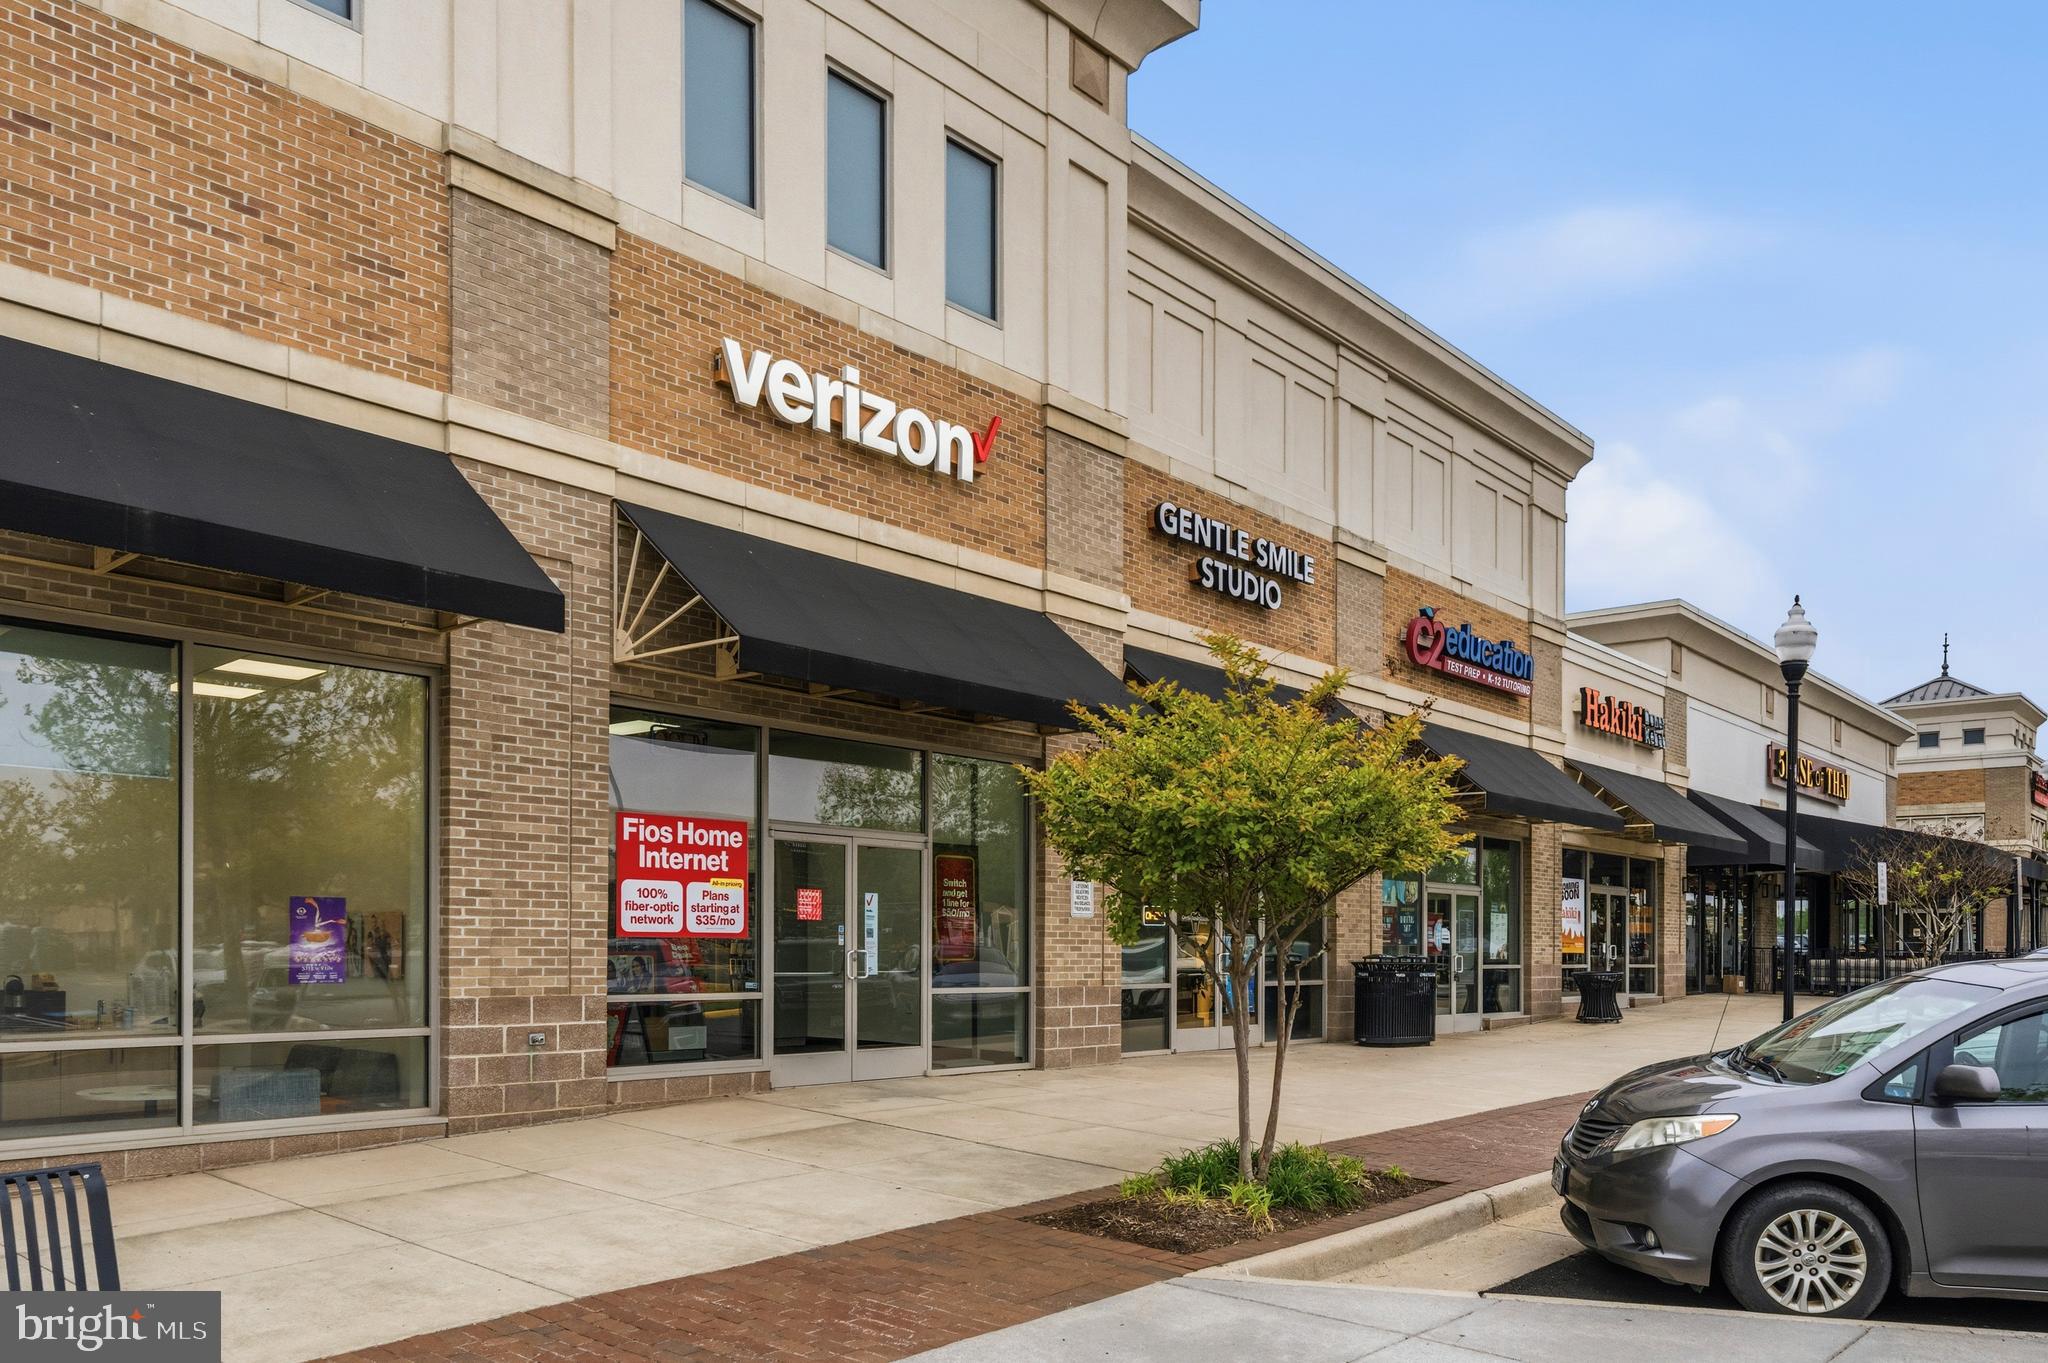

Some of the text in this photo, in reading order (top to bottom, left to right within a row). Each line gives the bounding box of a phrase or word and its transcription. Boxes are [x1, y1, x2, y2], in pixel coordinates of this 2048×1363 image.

[720, 337, 974, 483] verizon
[1158, 502, 1315, 585] GENTLE SMILE
[1200, 557, 1282, 610] STUDIO
[1445, 623, 1533, 681] education
[1447, 660, 1531, 695] TEST PREP K-12 TUTORING
[1582, 687, 1643, 742] Hakiki
[1826, 767, 1850, 800] THAI
[623, 817, 743, 848] Fios Home
[639, 844, 729, 872] Internet
[636, 887, 668, 899] 100%
[702, 890, 729, 901] Plans
[943, 878, 967, 887] Switch
[625, 901, 679, 913] fiber-optic
[691, 903, 740, 915] starting at
[946, 899, 959, 907] line
[630, 914, 674, 925] network
[695, 915, 736, 926] $35/mo
